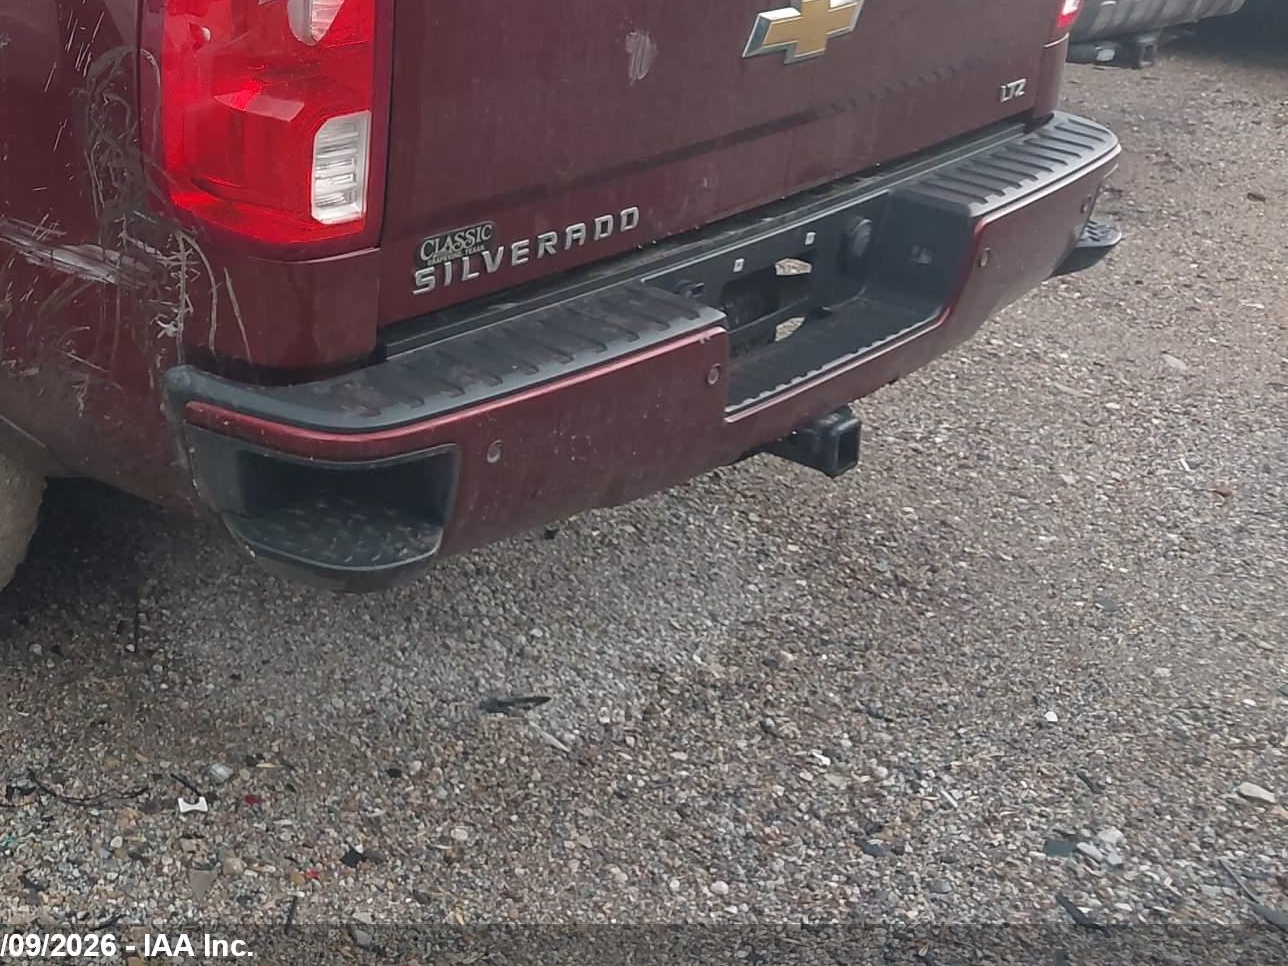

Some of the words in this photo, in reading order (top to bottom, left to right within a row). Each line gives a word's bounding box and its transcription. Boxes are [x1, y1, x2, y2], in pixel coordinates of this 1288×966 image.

[999, 77, 1028, 103] LTZ
[412, 205, 640, 295] SILVERADO
[420, 224, 493, 262] CLASSIC
